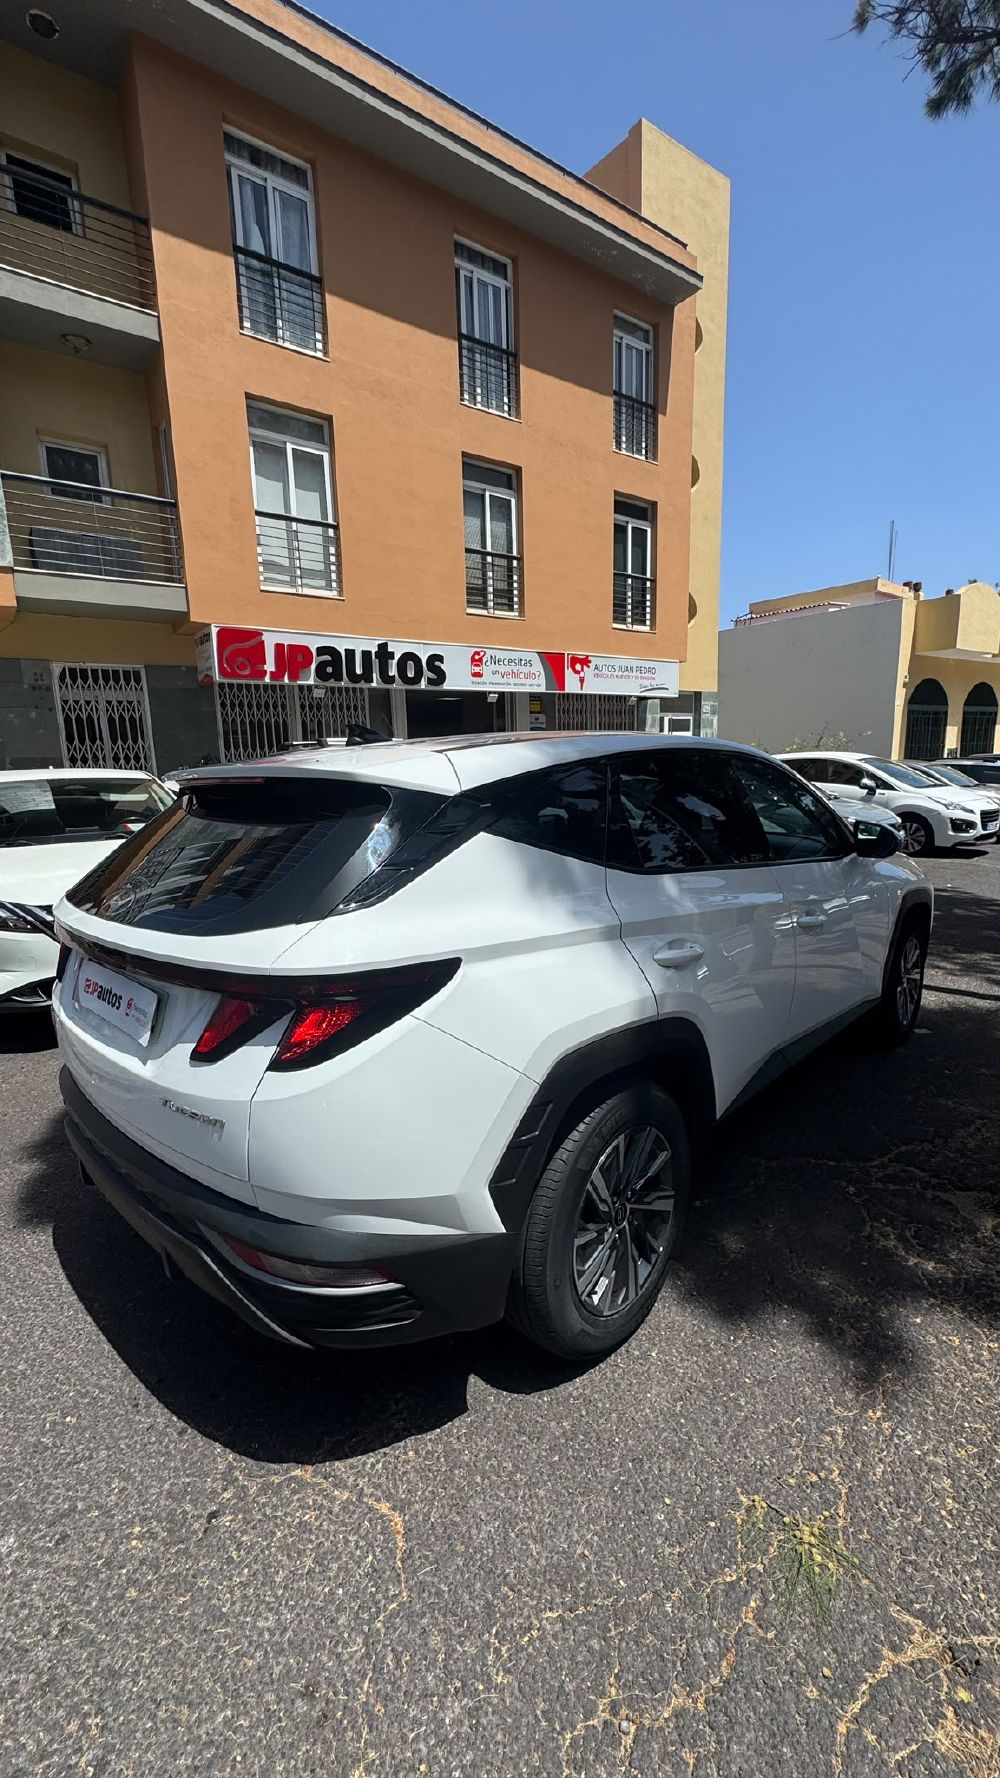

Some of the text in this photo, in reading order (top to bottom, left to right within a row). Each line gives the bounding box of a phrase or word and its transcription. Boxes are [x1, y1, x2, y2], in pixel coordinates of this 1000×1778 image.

[485, 654, 533, 667] ¿Necesitas
[500, 669, 541, 681] vehículo?
[593, 664, 656, 675] AUTOS JUAN PEDRO
